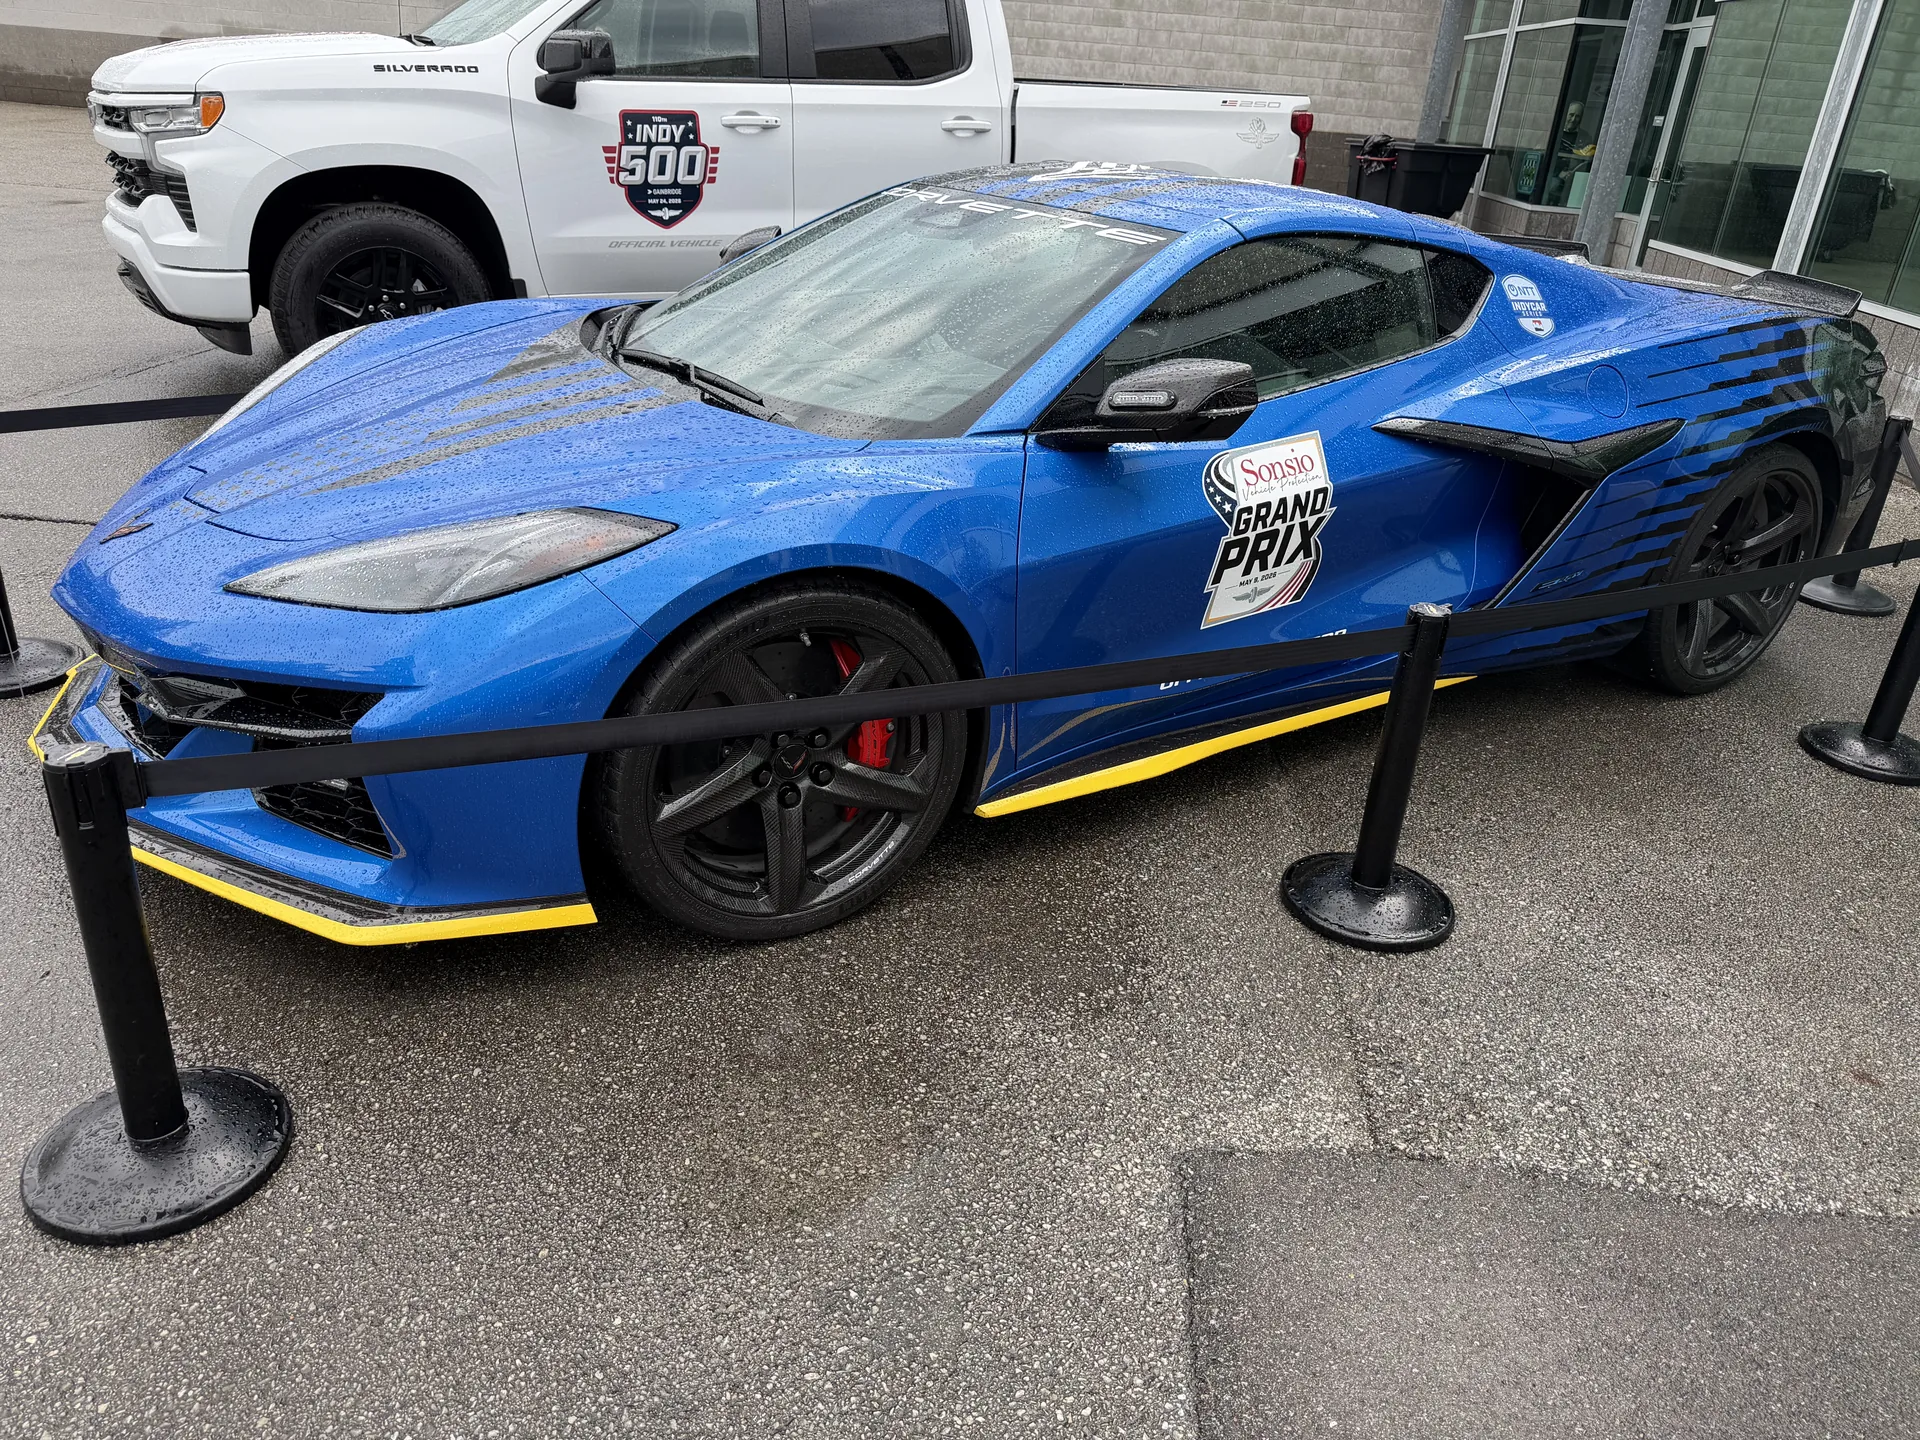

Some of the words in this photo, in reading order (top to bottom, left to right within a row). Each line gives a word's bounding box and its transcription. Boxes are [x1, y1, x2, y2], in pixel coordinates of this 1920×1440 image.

[373, 64, 480, 73] SILVERADO
[1239, 100, 1282, 109] 250
[635, 124, 686, 143] INDY
[618, 145, 707, 185] 500
[608, 240, 667, 249] OFFICIAL
[669, 239, 723, 247] VEHICLE
[1518, 286, 1536, 296] NTT
[1511, 301, 1547, 312] INDYCAR
[1240, 448, 1315, 487] Sonsio
[1241, 481, 1276, 502] Vehicle
[1276, 472, 1323, 493] Protection
[1232, 486, 1329, 537] GRAND
[1210, 514, 1329, 586] PRIX
[1238, 578, 1253, 588] MAY
[848, 840, 895, 883] CORVETTE
